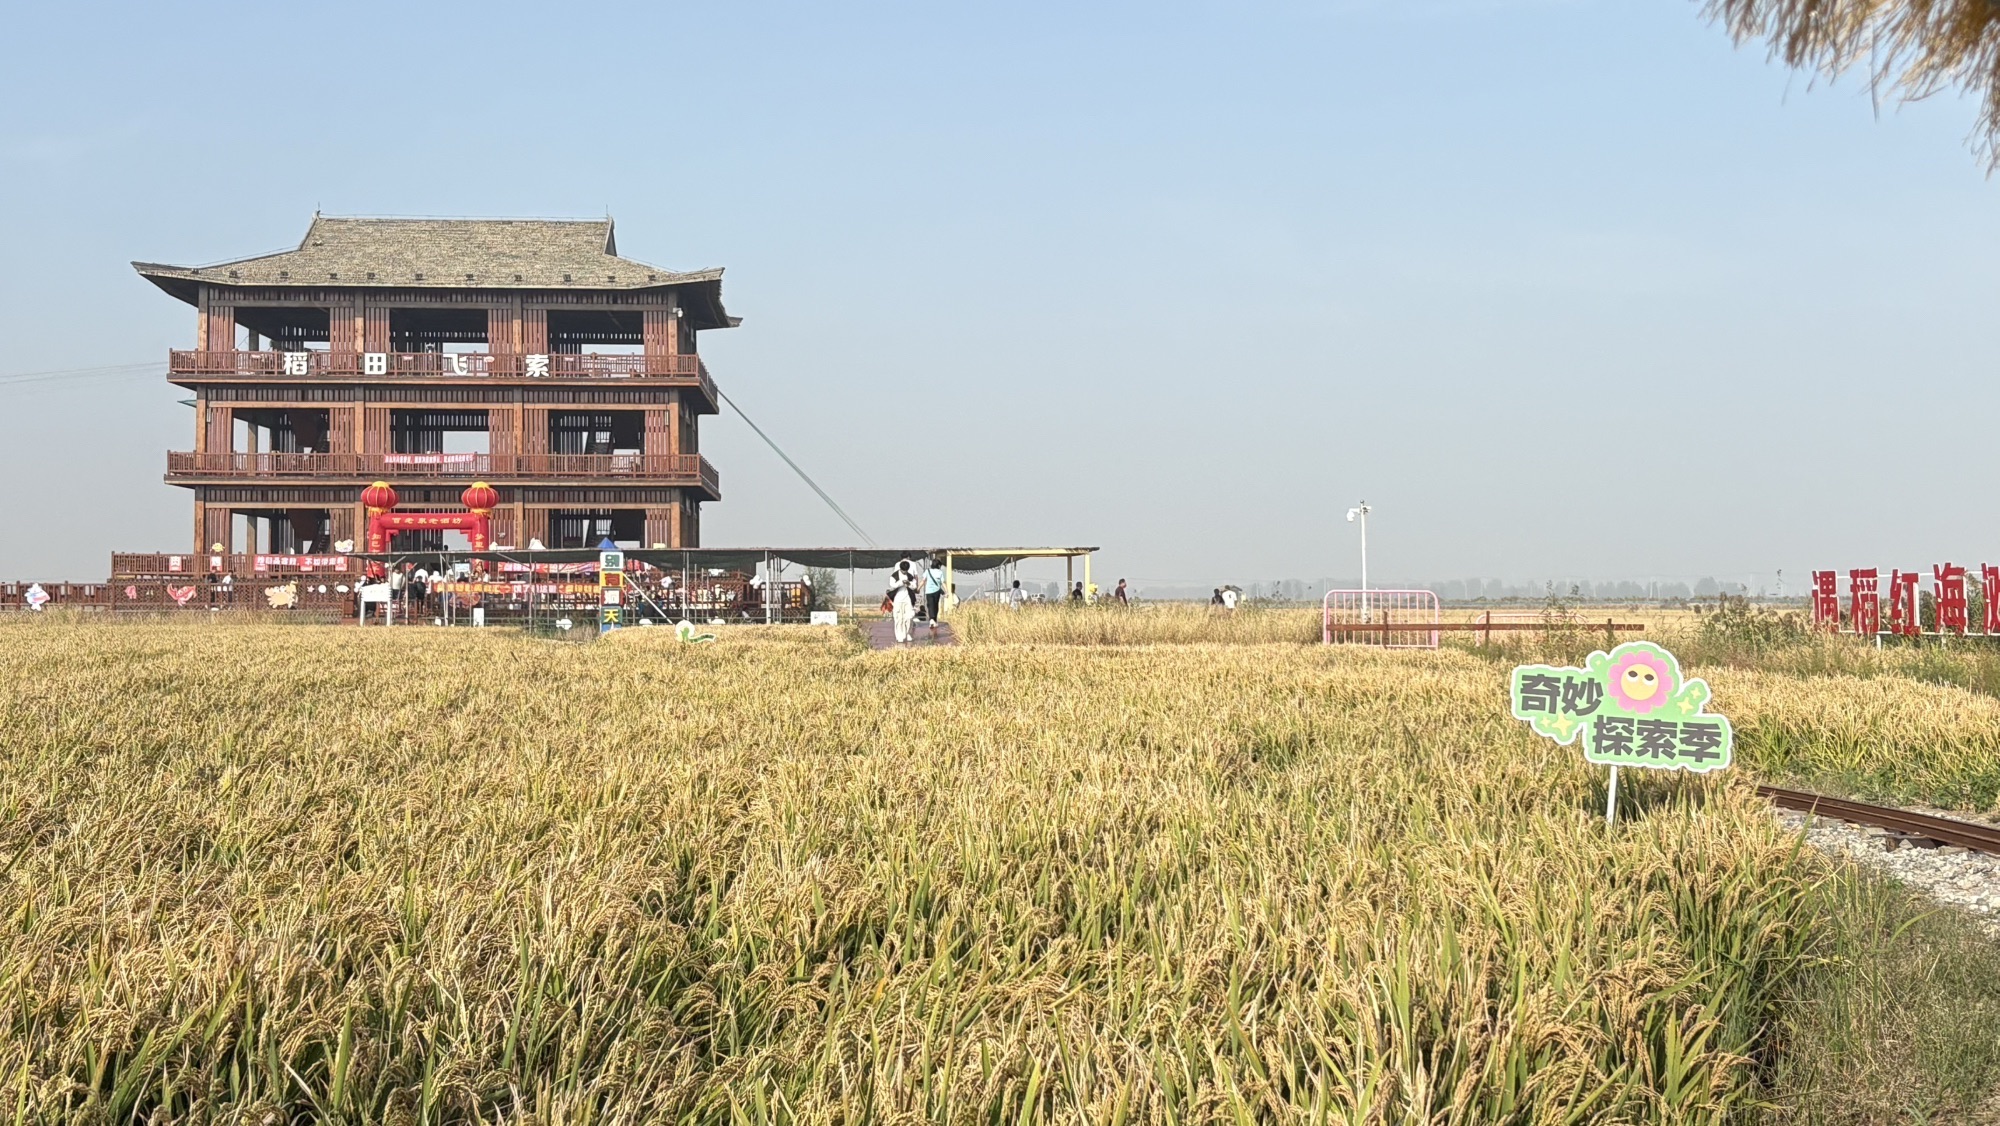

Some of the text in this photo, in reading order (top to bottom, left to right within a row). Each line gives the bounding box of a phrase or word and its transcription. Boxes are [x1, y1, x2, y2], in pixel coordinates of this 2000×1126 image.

[283, 352, 550, 377] 稻田飞索
[1520, 673, 1604, 716] 奇妙
[1592, 715, 1722, 763] 探索季
